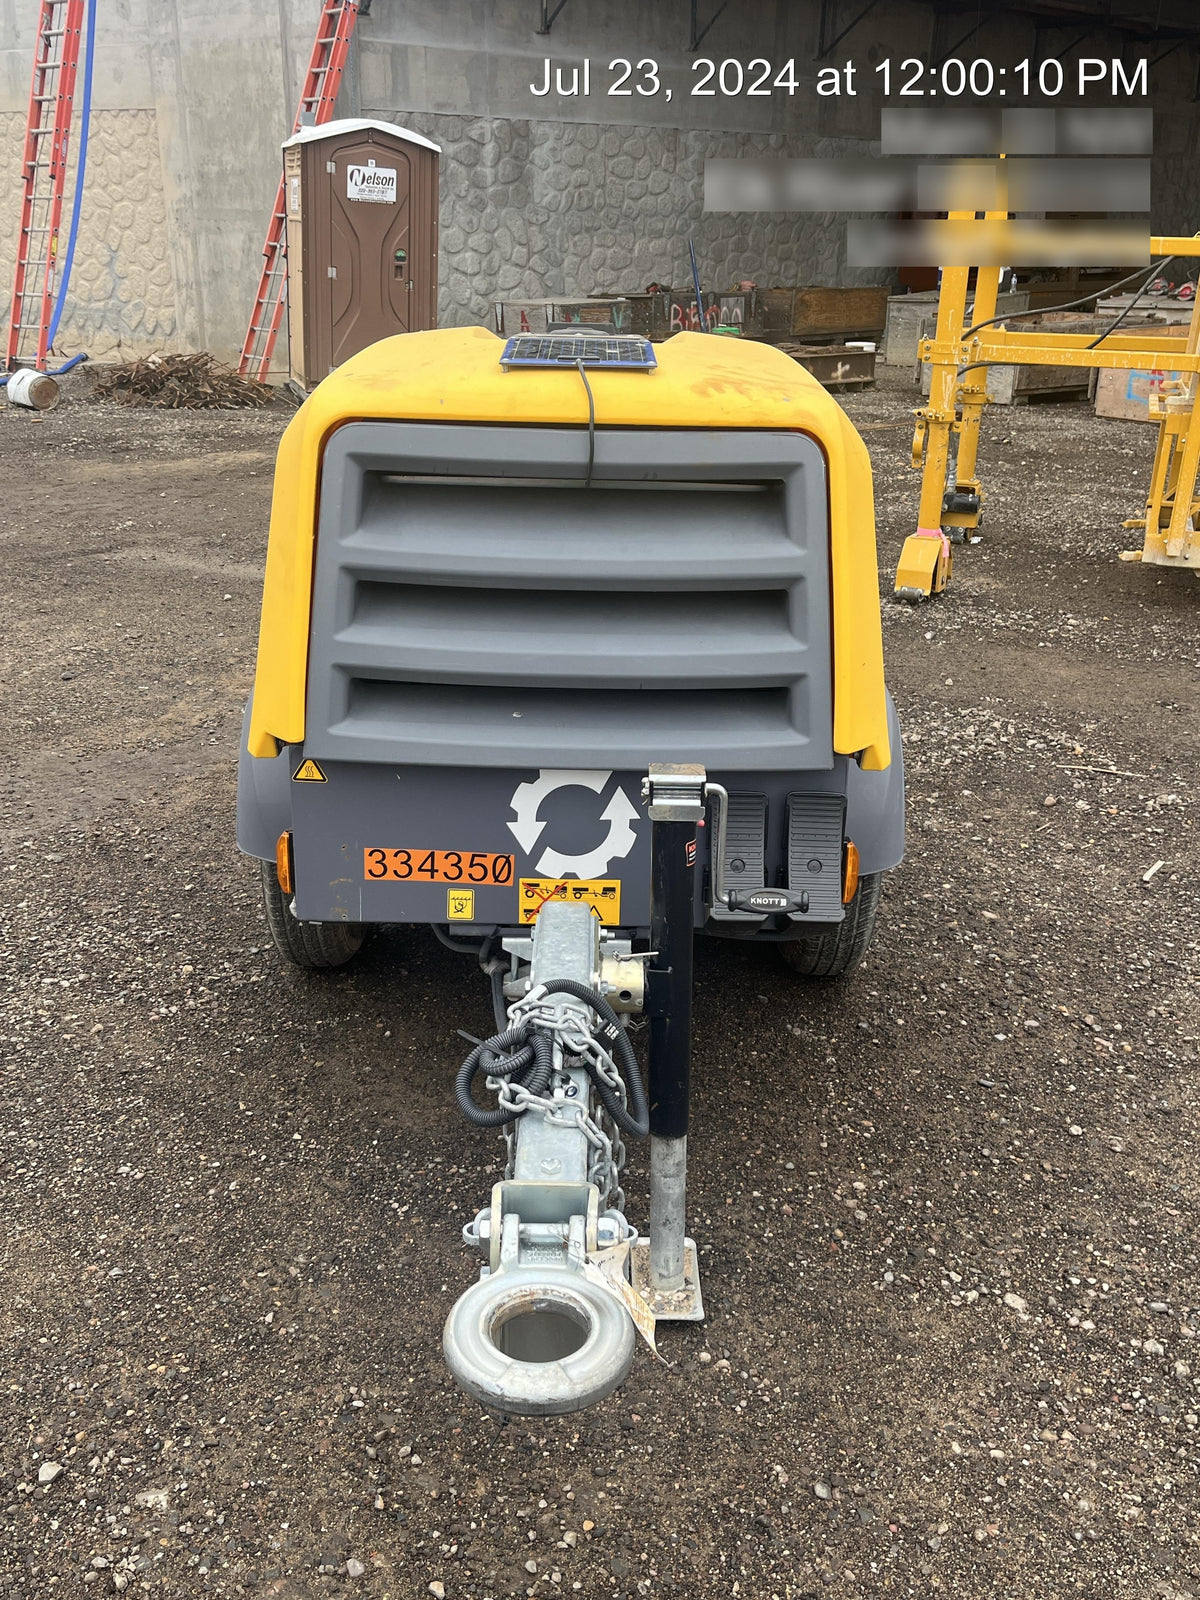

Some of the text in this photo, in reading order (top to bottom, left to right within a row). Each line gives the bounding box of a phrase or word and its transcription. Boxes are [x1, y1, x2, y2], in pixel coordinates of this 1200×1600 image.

[350, 168, 394, 186] Nelson
[367, 848, 512, 884] 334350
[750, 897, 780, 905] KNOTT
